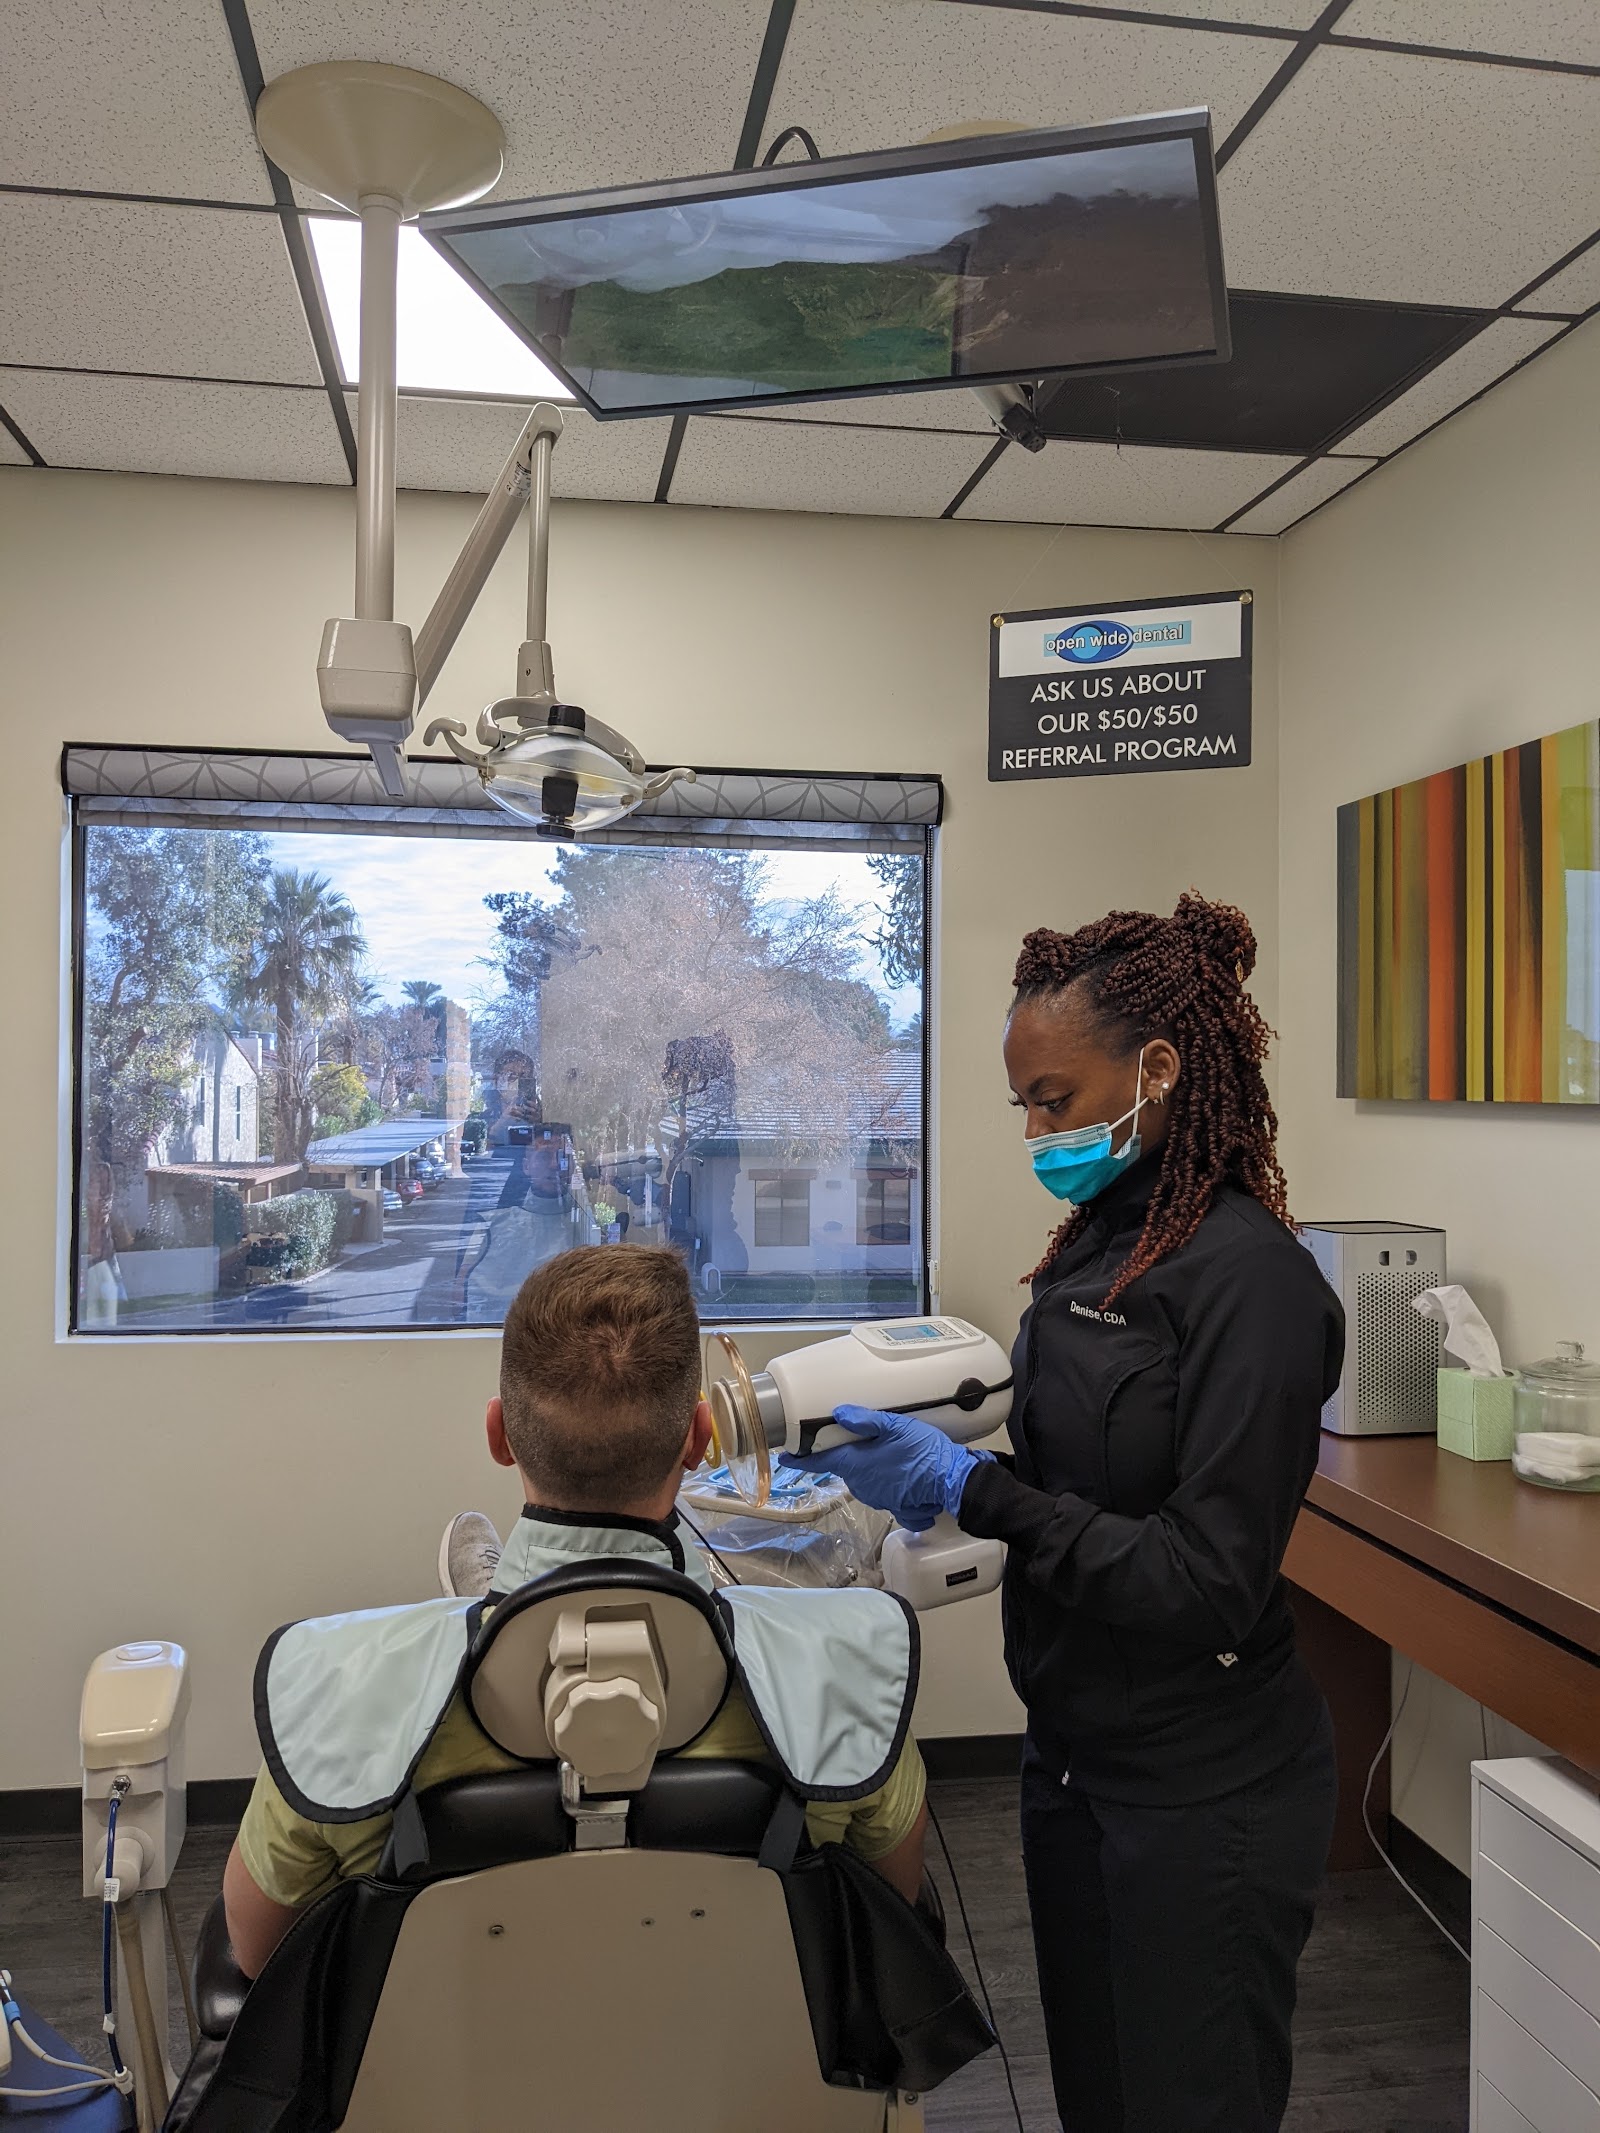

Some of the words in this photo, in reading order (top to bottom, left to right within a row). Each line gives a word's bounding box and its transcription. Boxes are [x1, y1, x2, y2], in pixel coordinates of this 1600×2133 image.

[1046, 635, 1085, 653] open
[1089, 630, 1128, 648] wide
[1132, 624, 1184, 644] dental
[1030, 680, 1075, 703] ASK
[1082, 677, 1113, 699] US
[1120, 669, 1207, 696] ABOUT
[1037, 713, 1091, 735] OUR
[1097, 703, 1199, 731] $50/$50
[1002, 744, 1106, 770] REFERRAL
[1114, 734, 1237, 762] PROGRAM
[1070, 1300, 1102, 1322] Denise,
[1103, 1311, 1127, 1326] CDA
